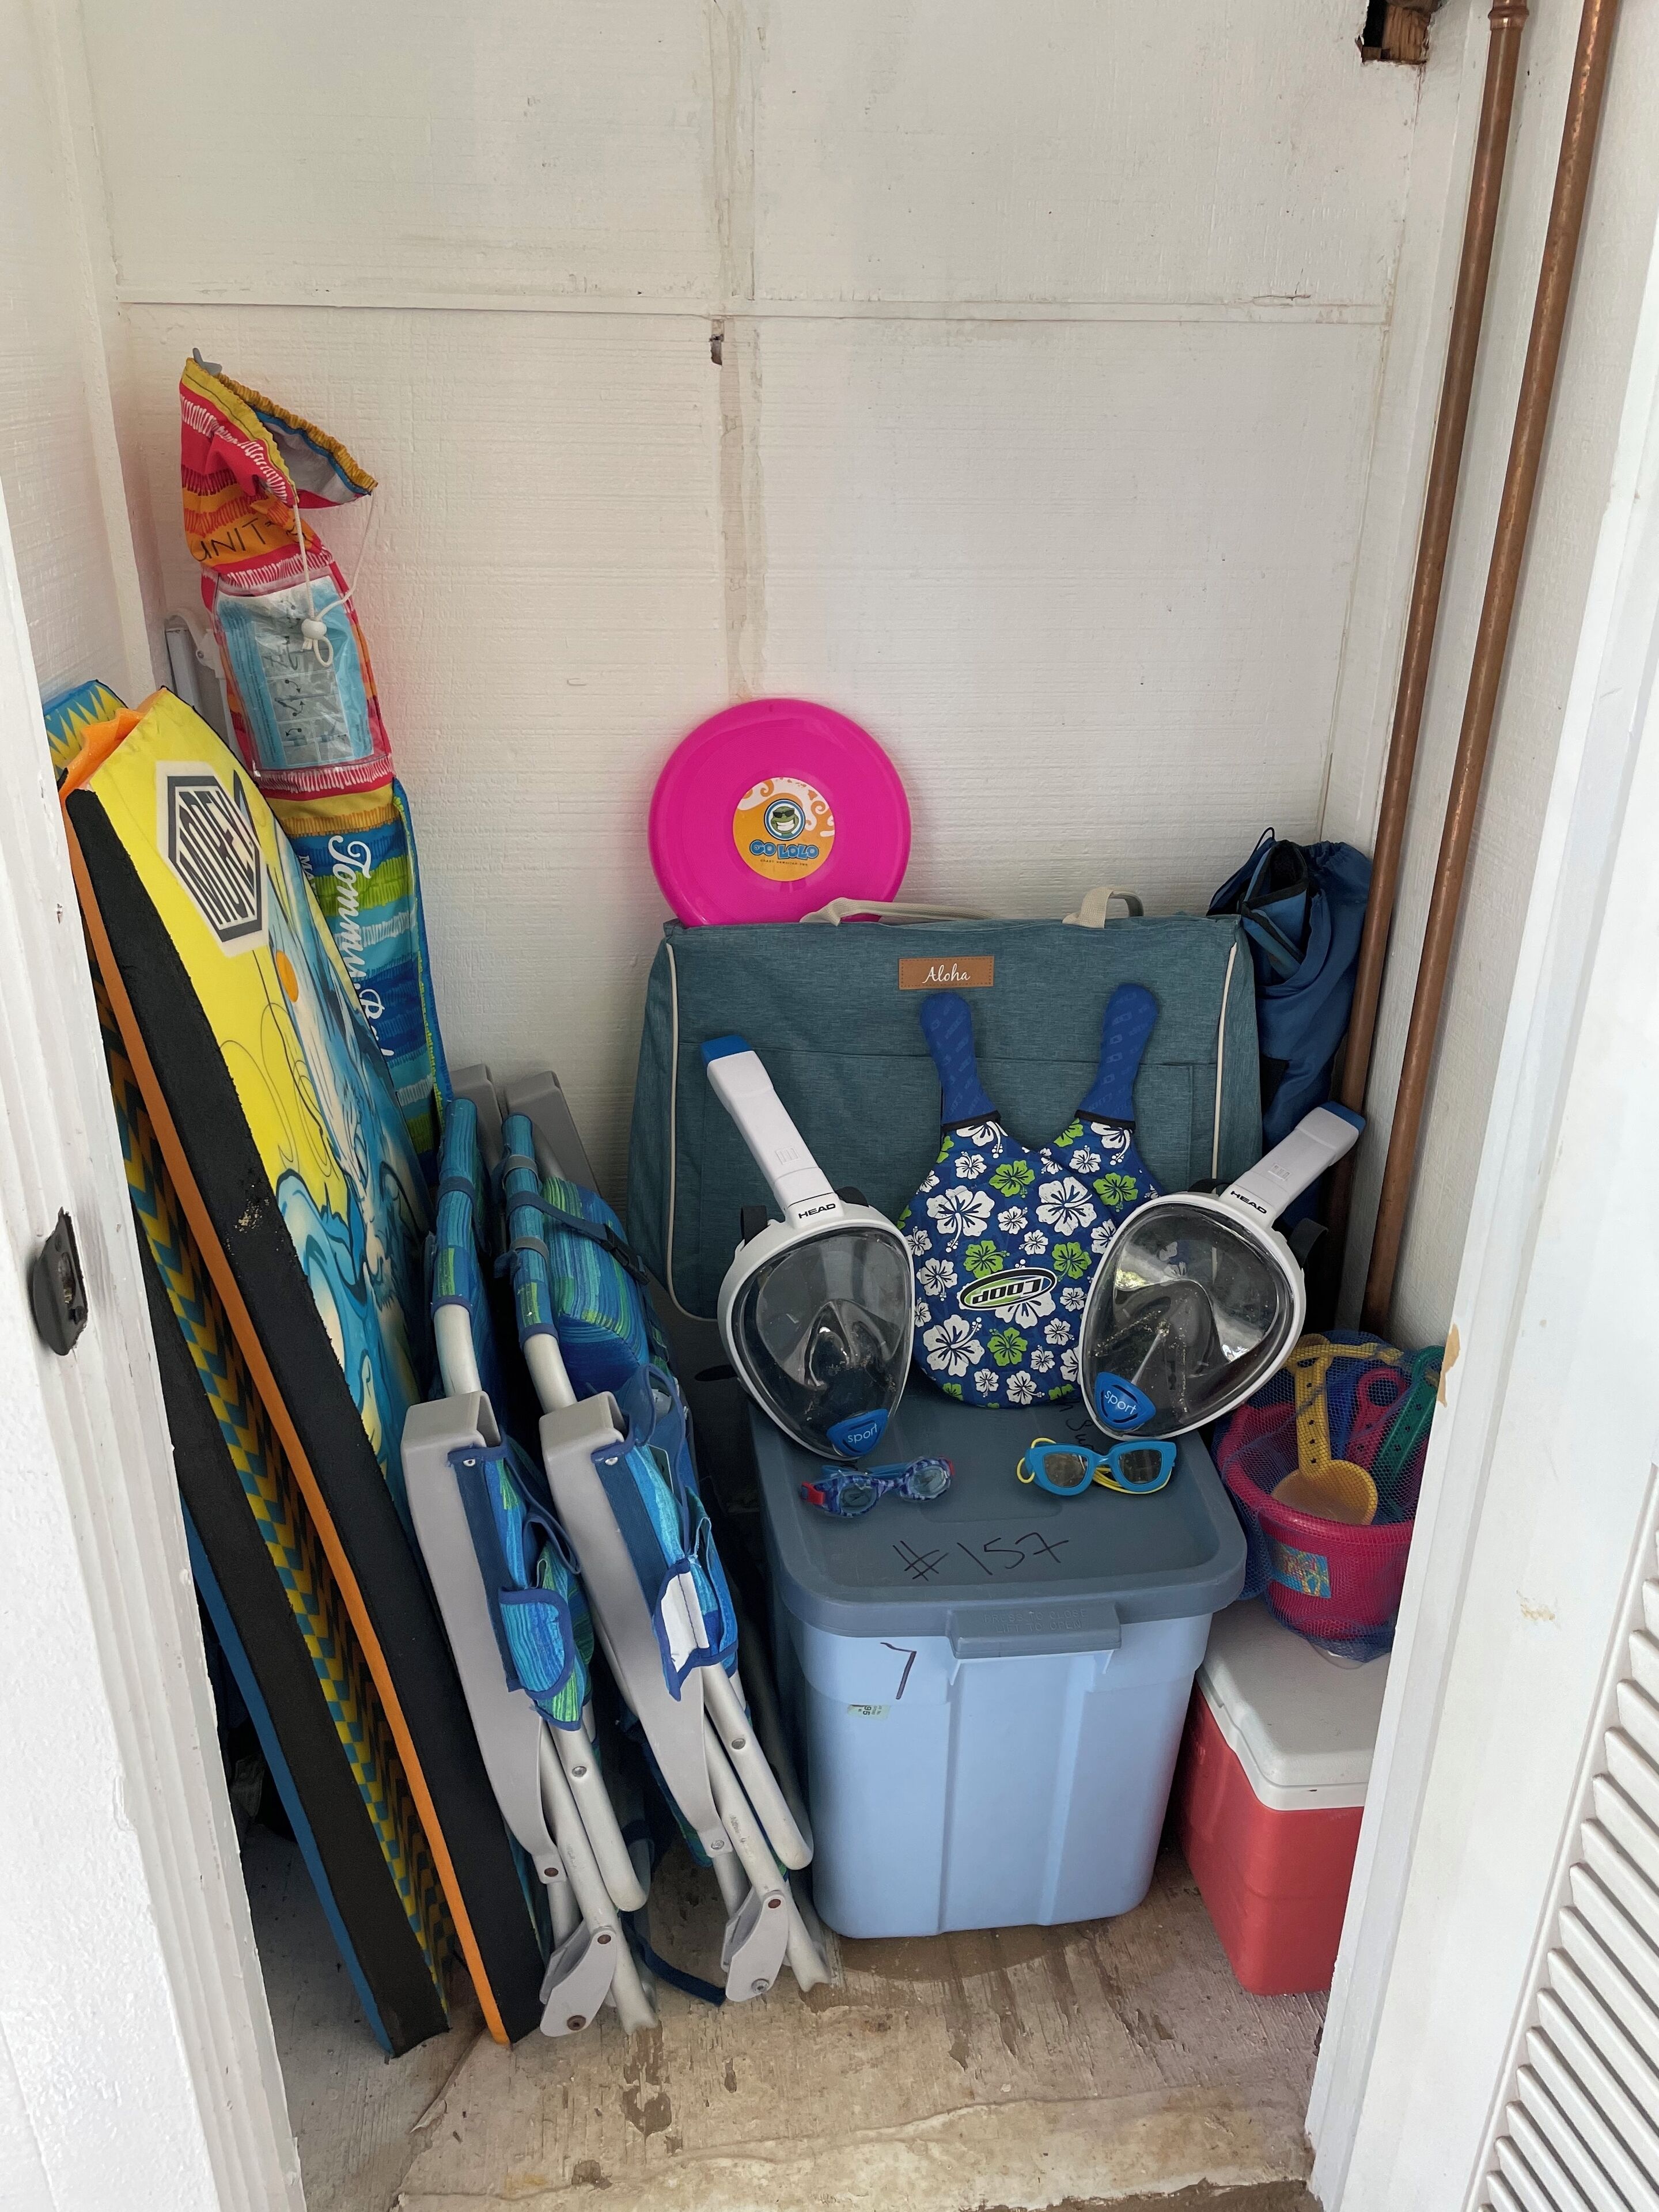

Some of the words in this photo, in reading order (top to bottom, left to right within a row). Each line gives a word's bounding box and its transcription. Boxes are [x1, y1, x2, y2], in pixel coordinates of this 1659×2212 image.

[195, 518, 266, 562] UNIT
[179, 790, 255, 925] MOREY
[749, 839, 777, 856] GO
[778, 843, 819, 860] LOLO
[922, 963, 971, 983] Aloha
[798, 1203, 836, 1219] HEAD
[1230, 1190, 1267, 1214] HEAD
[1104, 1389, 1138, 1416] sport
[847, 1423, 877, 1444] sport
[983, 1613, 1023, 1623] PRESS
[1028, 1612, 1043, 1622] TO
[1050, 1608, 1088, 1620] CLOSE
[996, 1623, 1020, 1634] LIFT
[1027, 1623, 1043, 1632] TO
[1050, 1620, 1082, 1631] OPEN
